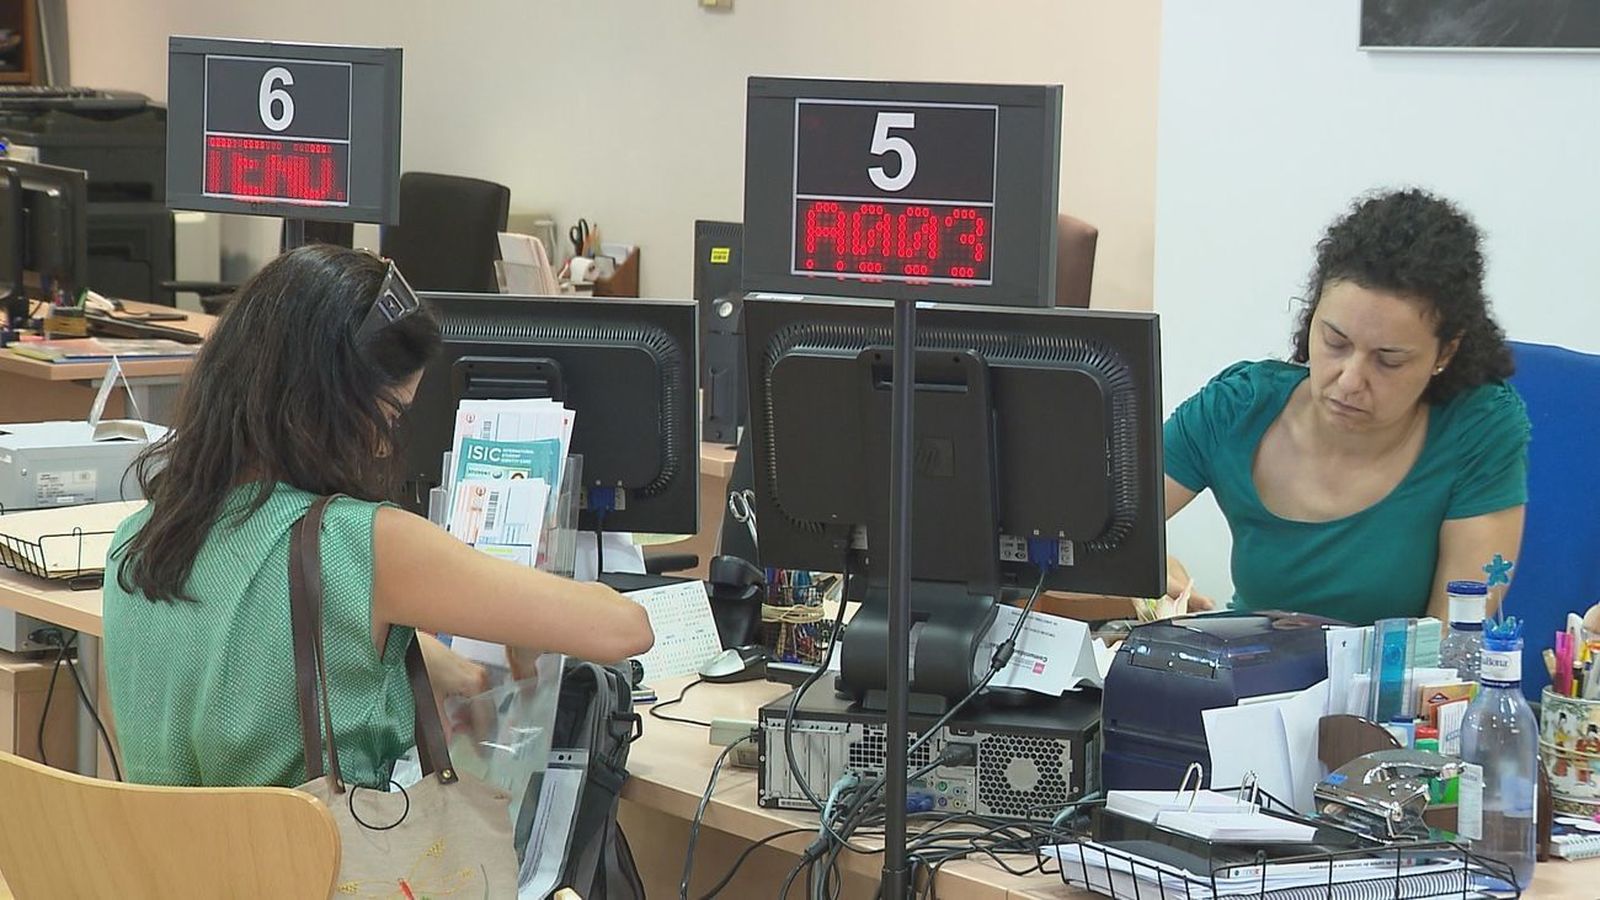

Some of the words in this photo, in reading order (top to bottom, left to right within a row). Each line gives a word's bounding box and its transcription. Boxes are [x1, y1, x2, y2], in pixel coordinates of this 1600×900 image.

[258, 66, 295, 131] 6
[867, 112, 918, 192] 5
[804, 202, 984, 278] A003
[467, 444, 502, 462] ISIC
